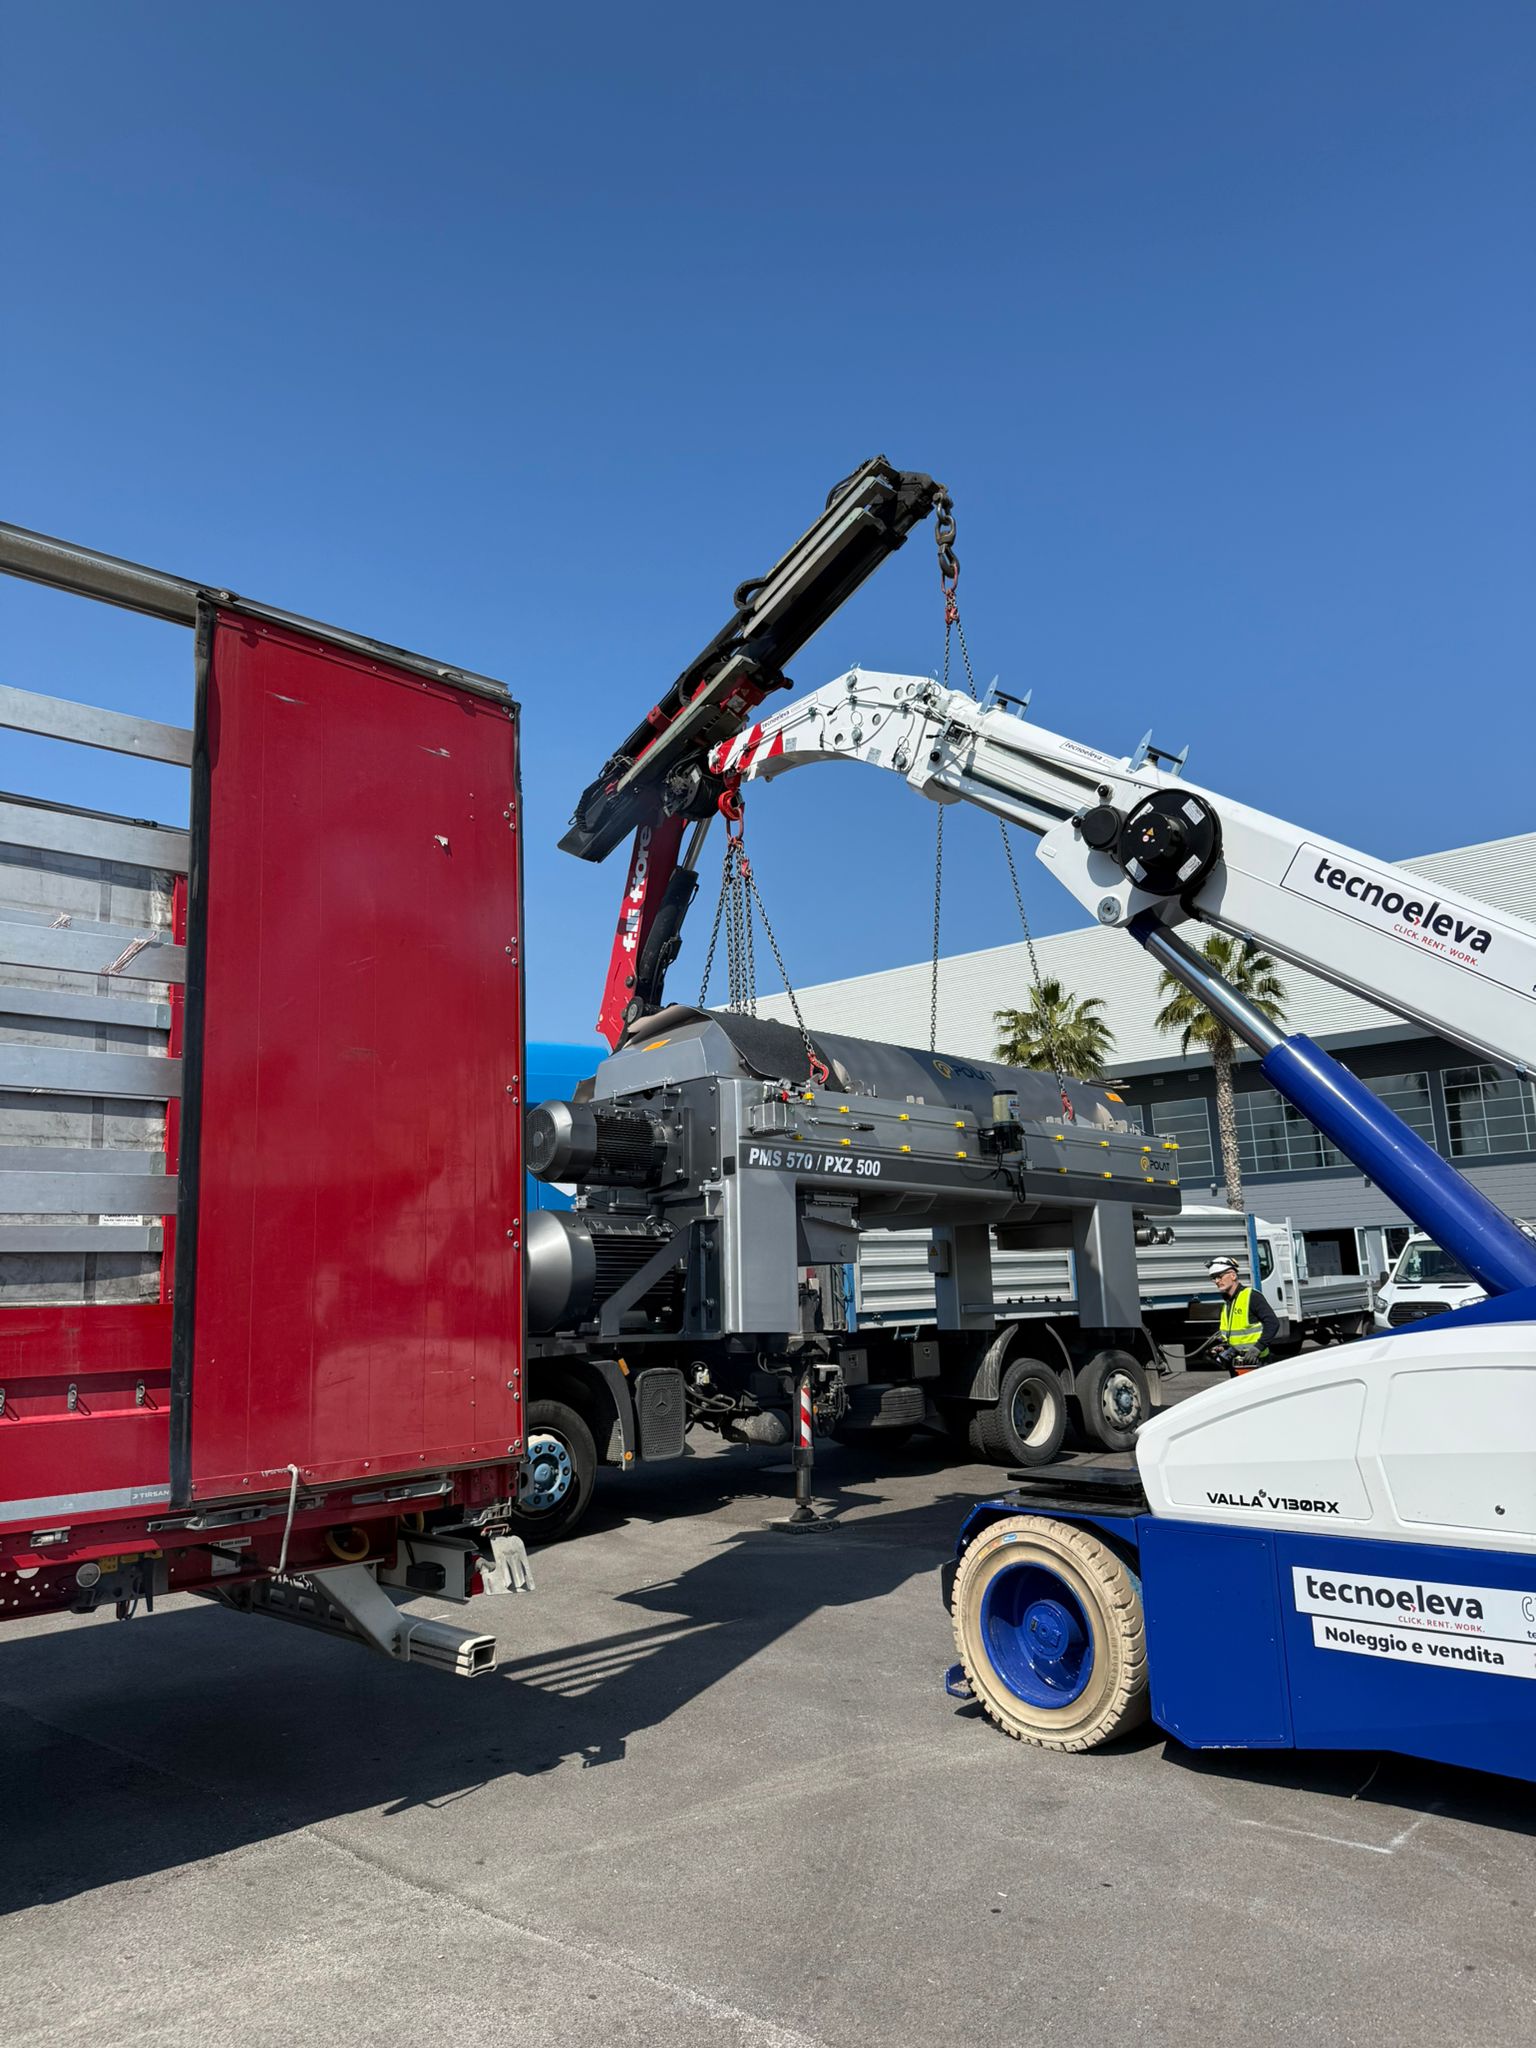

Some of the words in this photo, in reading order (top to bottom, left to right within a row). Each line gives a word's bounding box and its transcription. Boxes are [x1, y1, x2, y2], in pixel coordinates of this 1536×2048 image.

[1065, 742, 1103, 760] tecnoeleva
[1314, 857, 1492, 954] tecnoeleva
[1393, 923, 1419, 941] CLICK.
[1421, 936, 1446, 953] RENT.
[1449, 948, 1479, 967] WORK.
[748, 1147, 783, 1167] PMS
[786, 1151, 813, 1170] 570
[815, 1154, 822, 1171] /
[824, 1155, 853, 1174] PXZ
[855, 1159, 881, 1177] 500
[140, 1489, 170, 1498] TIRSAN
[1206, 1492, 1263, 1508] VALLA
[1267, 1496, 1340, 1514] V130RX
[1306, 1575, 1484, 1620] tecnoeleva
[1398, 1615, 1425, 1626] CLICK.
[1426, 1619, 1453, 1630] RENT.
[1454, 1622, 1486, 1633] WORK.
[1325, 1626, 1408, 1652] Noleggio
[1412, 1641, 1423, 1654] e
[1427, 1643, 1504, 1665] vendita
